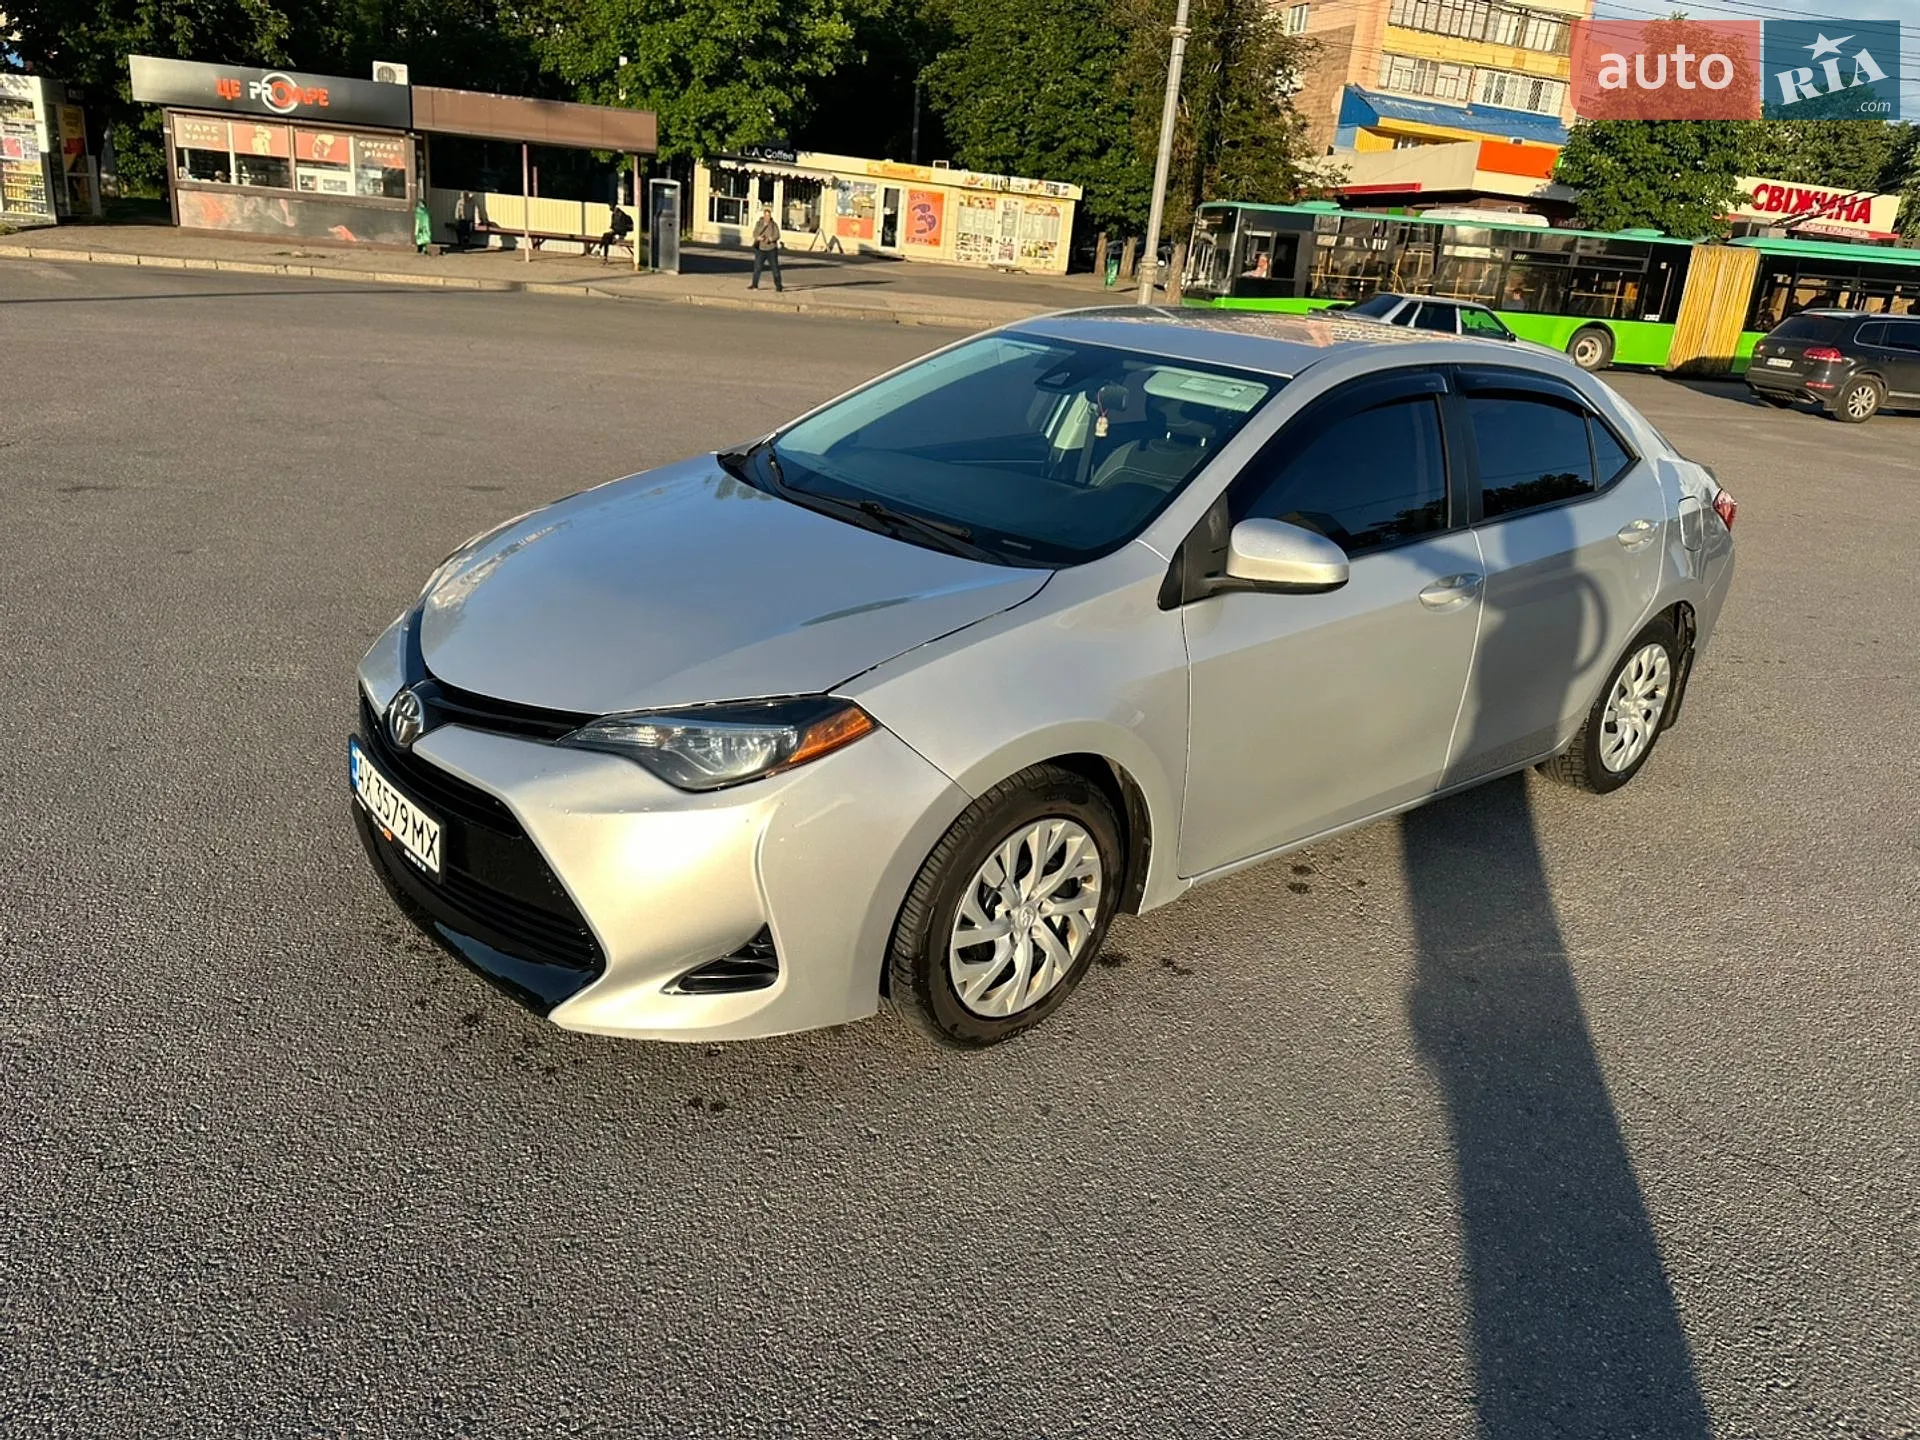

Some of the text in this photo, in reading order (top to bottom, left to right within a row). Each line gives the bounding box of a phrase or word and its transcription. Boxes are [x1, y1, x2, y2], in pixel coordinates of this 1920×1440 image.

[216, 79, 241, 100] ЦЕ
[184, 123, 219, 134] VAPE
[764, 148, 794, 162] Coffee
[1751, 183, 1872, 224] СВІЖИНА
[375, 776, 409, 836] 3579
[411, 811, 438, 866] MX
